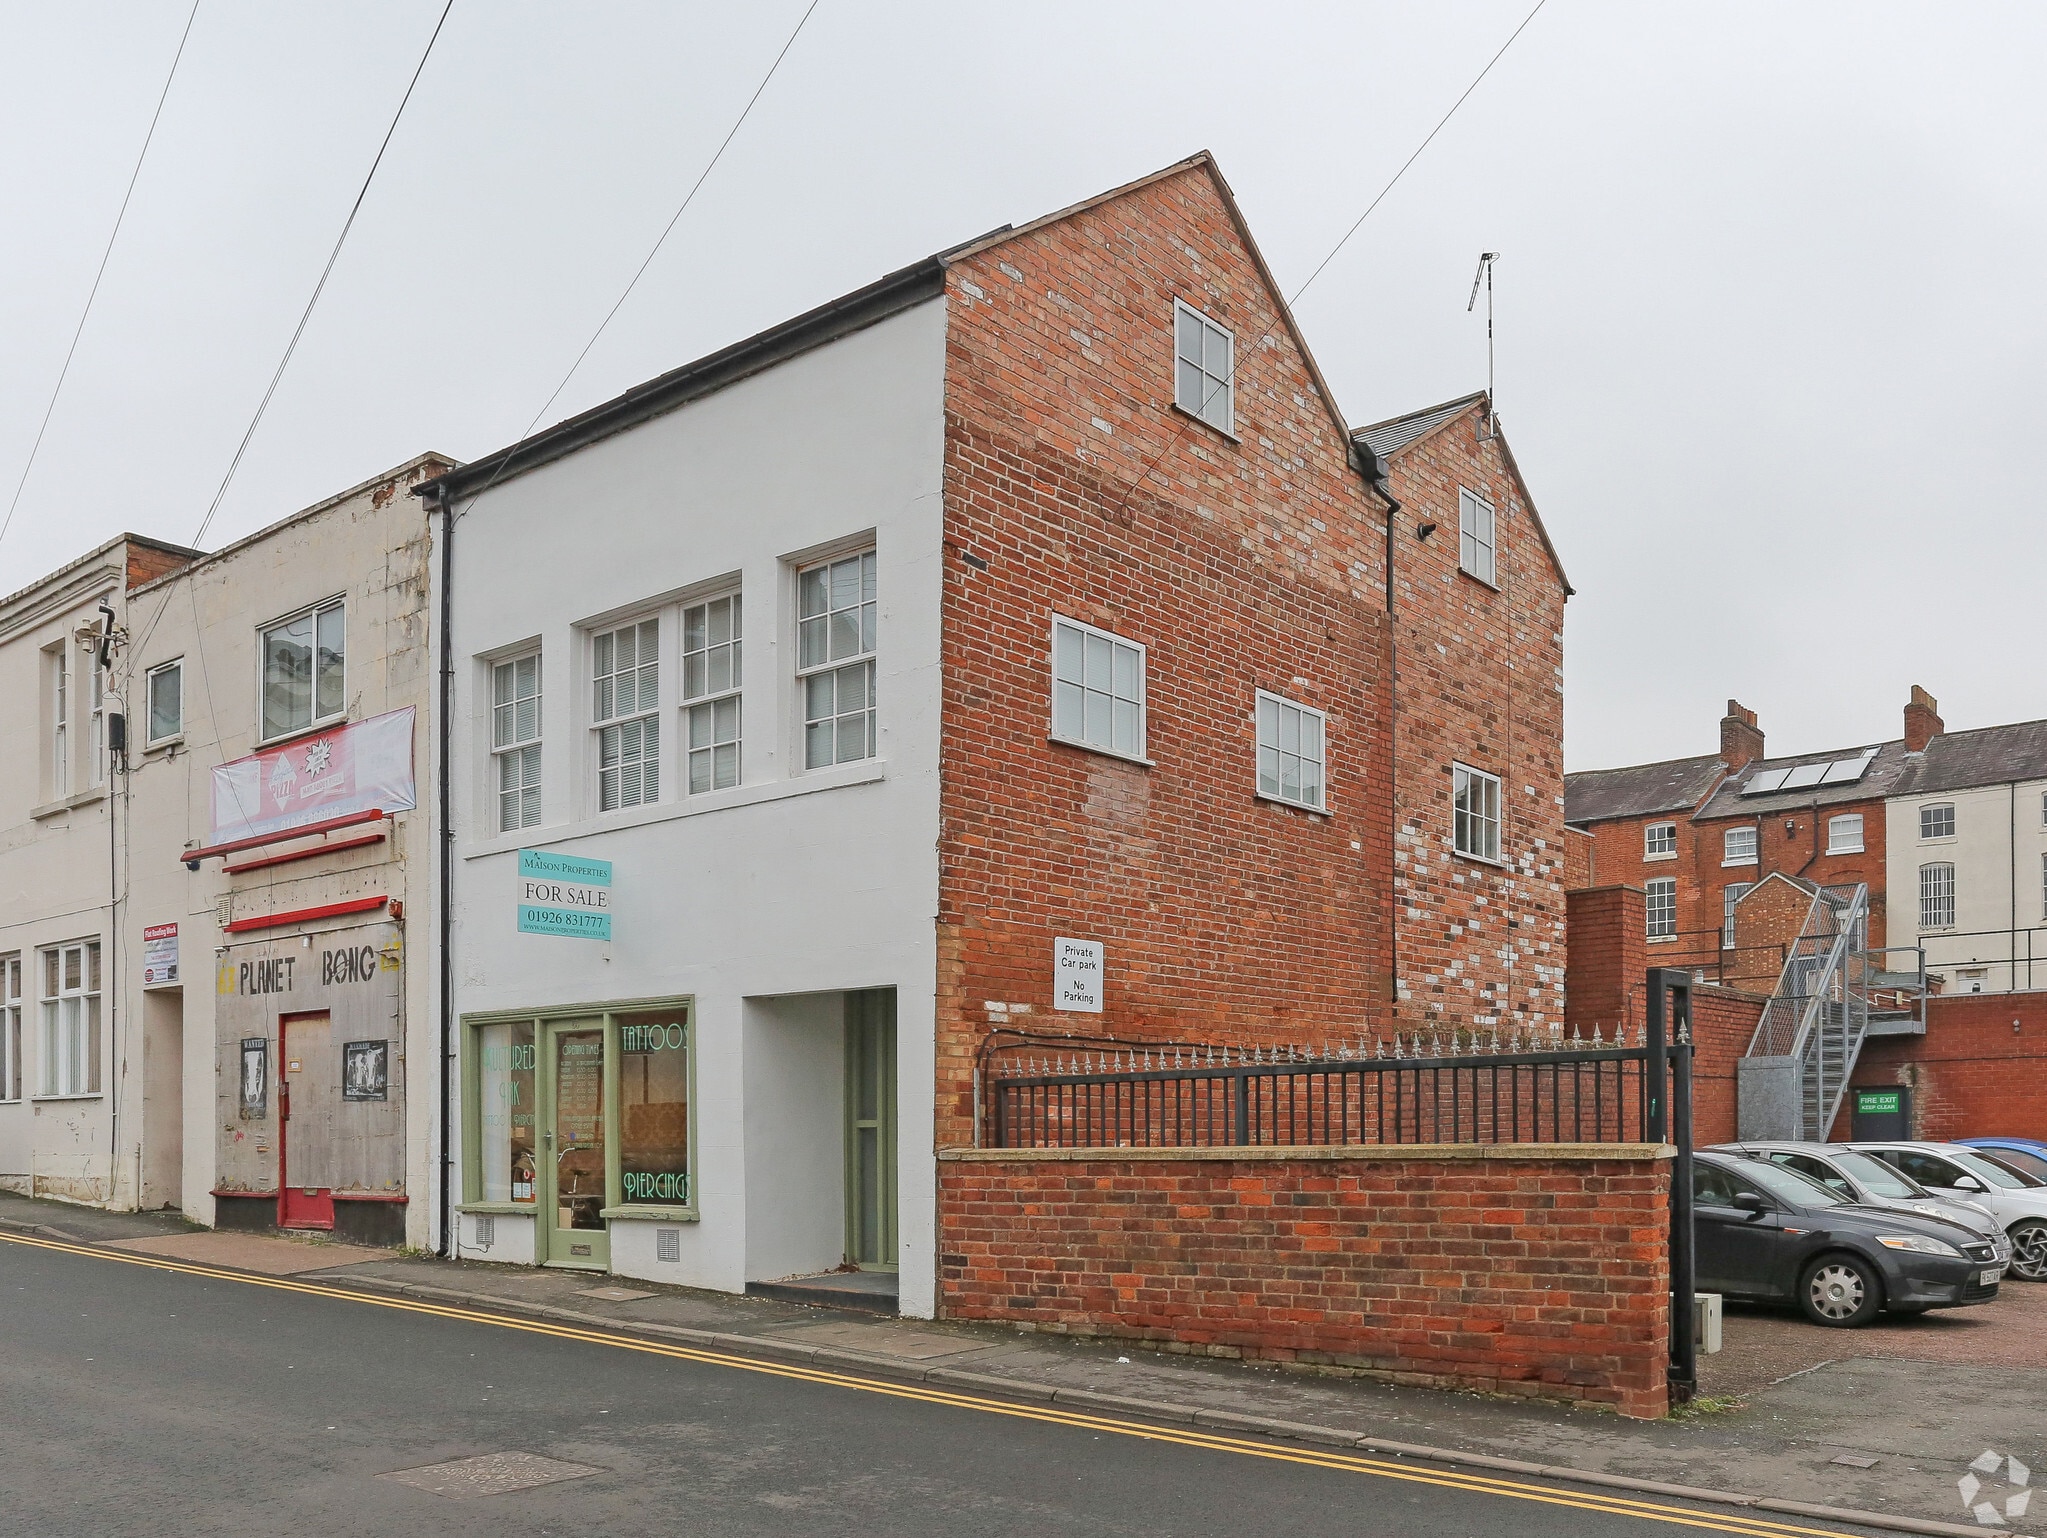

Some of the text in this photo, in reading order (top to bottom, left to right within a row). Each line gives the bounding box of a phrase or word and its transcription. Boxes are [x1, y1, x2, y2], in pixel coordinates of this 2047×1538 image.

[270, 780, 294, 800] PIZZA
[525, 859, 608, 878] MAISON PROPERTIES
[525, 883, 608, 908] FOR SALE
[528, 910, 603, 928] 01926 831777
[166, 925, 177, 935] Work
[1065, 945, 1094, 957] Private
[240, 945, 376, 995] PLANET BONG
[1061, 957, 1097, 970] Car park
[1073, 980, 1085, 990] No
[1064, 991, 1094, 1004] Parking
[1880, 1096, 1897, 1104] EXIT
[623, 1172, 691, 1201] PIERCINGS
